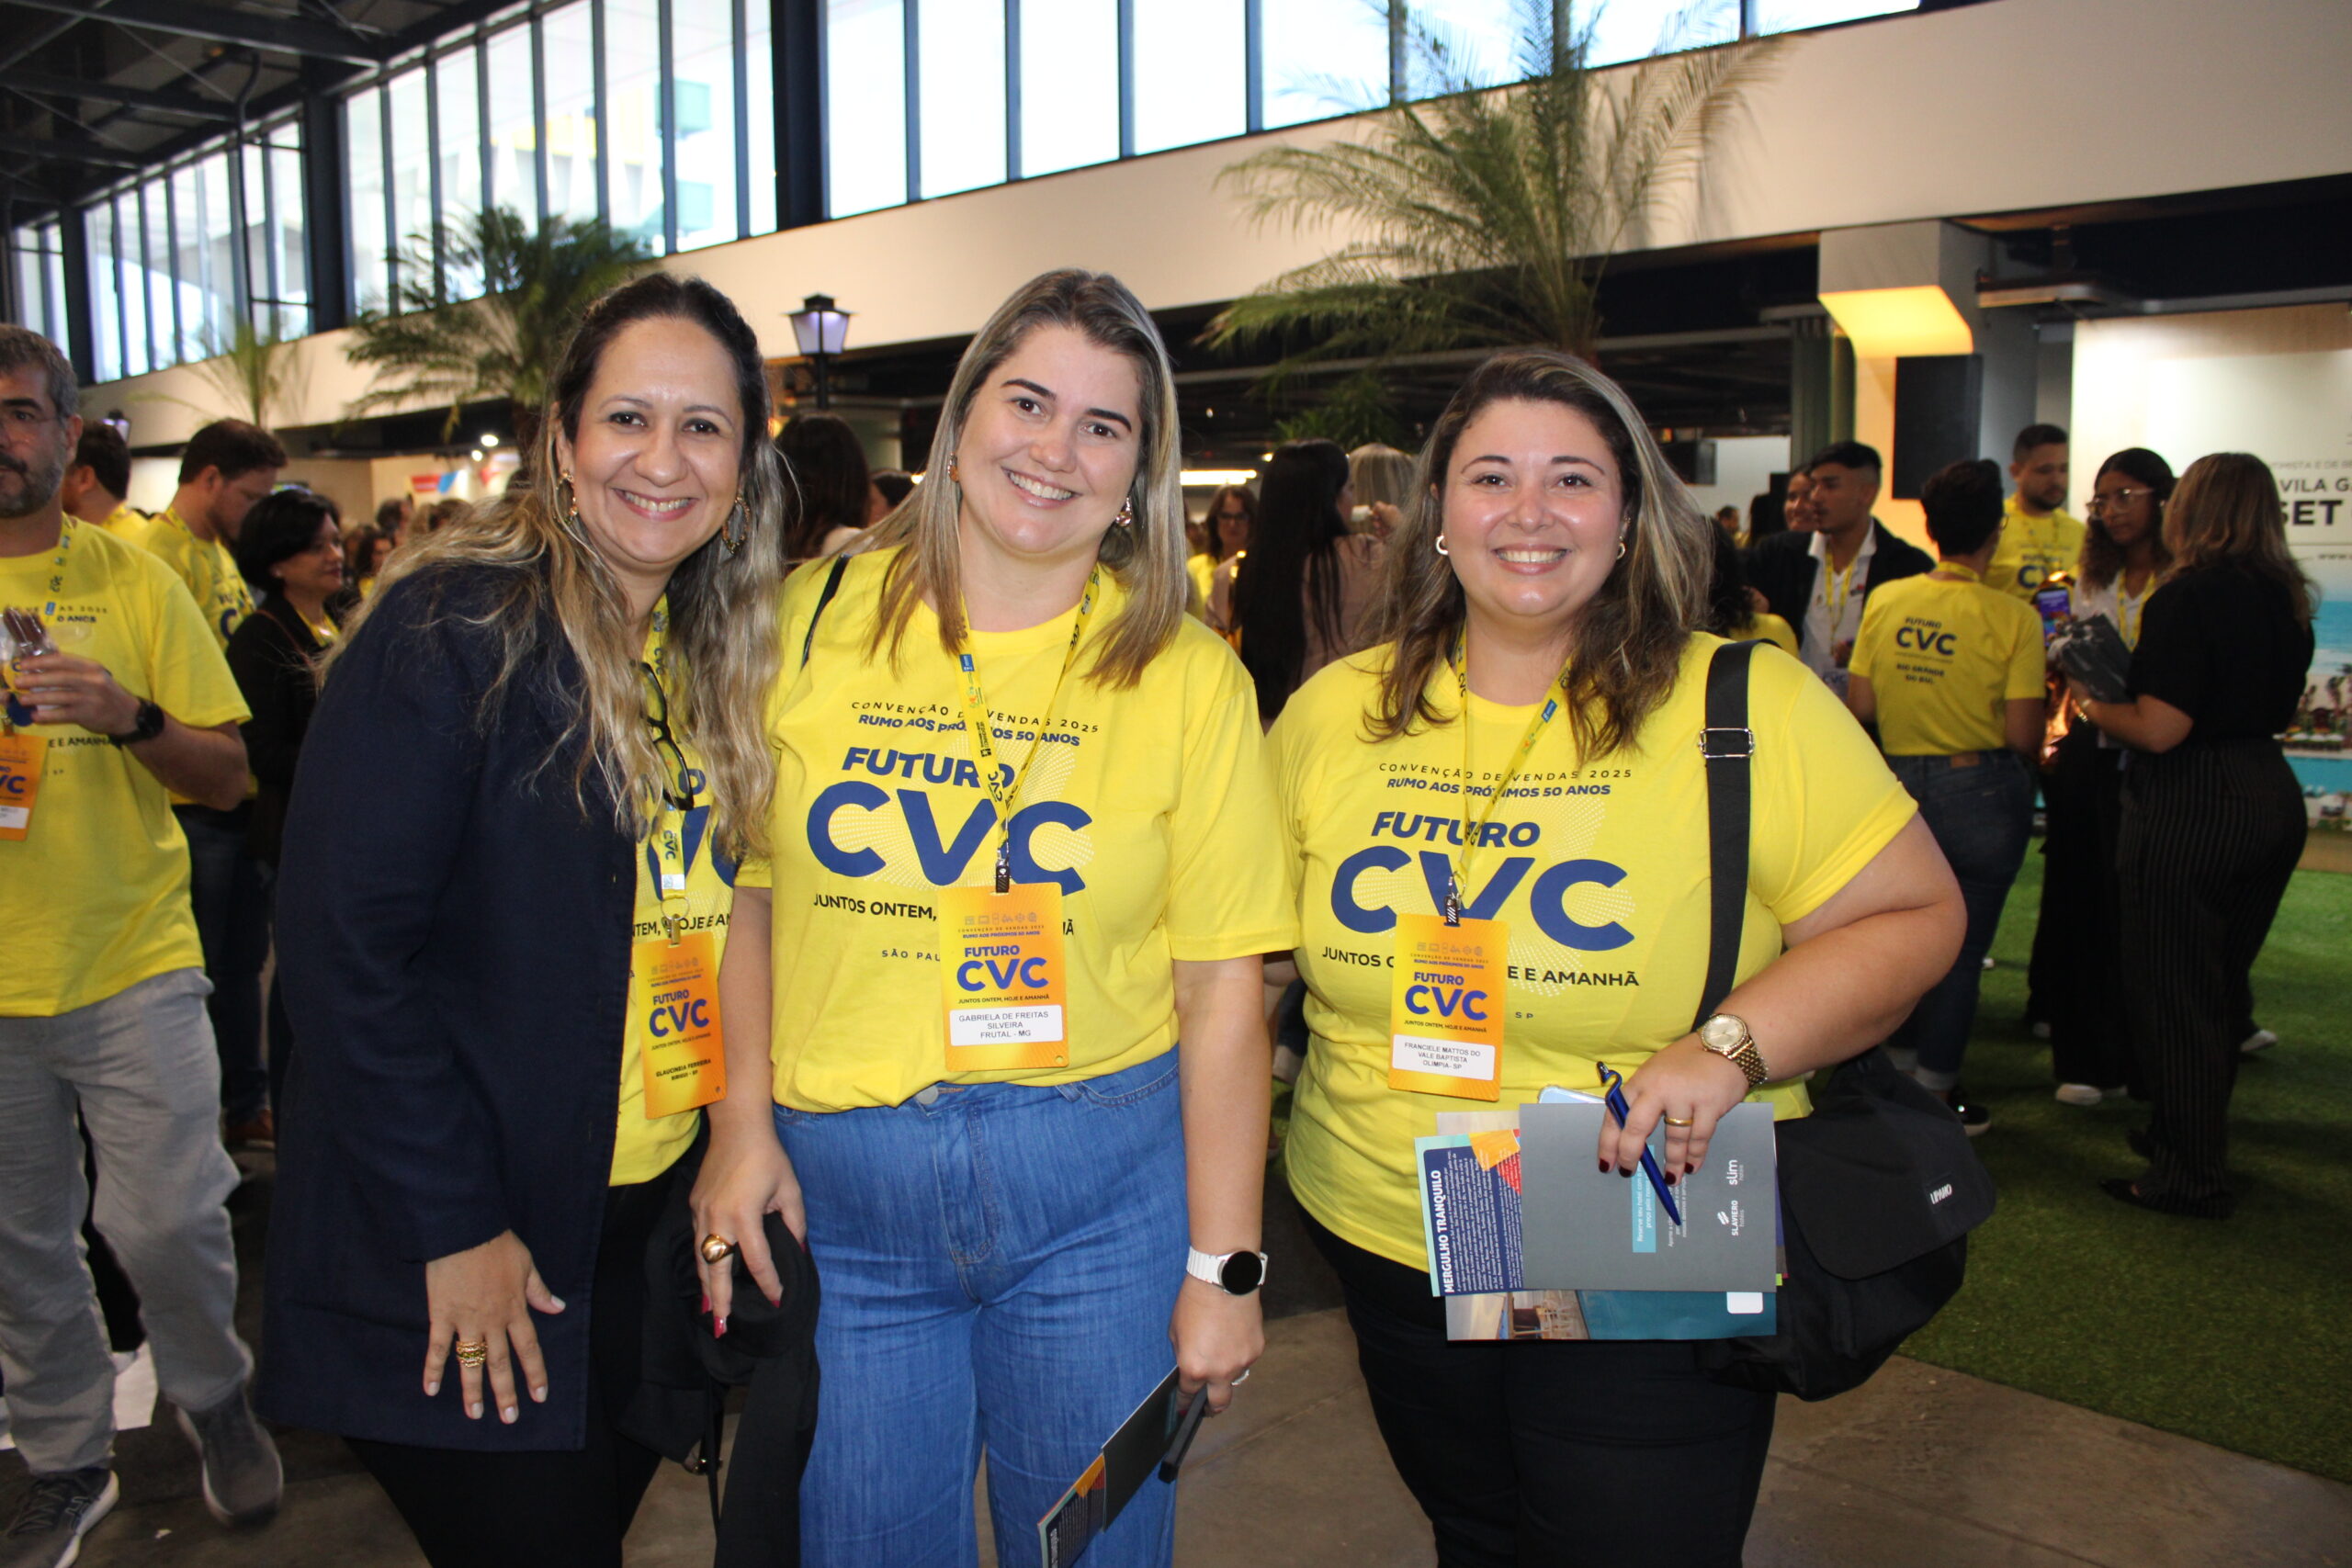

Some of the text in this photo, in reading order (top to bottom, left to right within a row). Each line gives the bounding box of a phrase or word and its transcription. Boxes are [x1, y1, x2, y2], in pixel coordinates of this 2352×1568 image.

[2279, 479, 2326, 492] VILA
[1896, 626, 1957, 656] CVC
[654, 647, 664, 675] CVC
[851, 701, 949, 716] CONVENÇÃO
[986, 709, 1052, 727] VENDAS
[1060, 718, 1100, 733] 2025
[858, 714, 904, 728] RUMO
[906, 716, 936, 732] AOS
[1013, 729, 1035, 742] 50
[1040, 732, 1080, 747] ANOS
[1379, 762, 1632, 782] CONVENÇÃO DE VENDAS 2025
[987, 771, 1003, 802] CVC
[1386, 778, 1611, 797] RUMO AOS PRÓIMOS 50 ANOS
[807, 780, 1093, 897] CVC
[1371, 811, 1541, 848] FUTURO
[663, 829, 677, 860] CVC
[813, 893, 938, 922] JUNTOS ONTEM,
[1330, 845, 1635, 951] CVC
[707, 915, 715, 928] E
[882, 947, 909, 959] SÃO
[964, 944, 1021, 958] FUTURO
[1322, 946, 1381, 967] JUNTOS
[956, 957, 1049, 991] CVC
[1414, 971, 1464, 987] FUTURO
[1525, 967, 1537, 981] E
[1542, 970, 1640, 987] AMANHÃ
[652, 989, 690, 1006] FUTURO
[1405, 985, 1488, 1021] CVC
[649, 998, 710, 1038] CVC
[958, 1013, 1001, 1022] GABRIELA
[987, 1021, 1023, 1030] SILVEIRA
[980, 1030, 1012, 1039] FRUTAL
[1464, 1025, 1487, 1033] AMANHÃ
[1404, 1042, 1442, 1054] FRANCIELE
[1442, 1047, 1470, 1056] MATTOS
[1436, 1054, 1468, 1064] BAPTISTA
[1453, 1062, 1462, 1070] SP
[1725, 1159, 1738, 1186] slim
[1730, 1201, 1739, 1236] SLAVIERO
[1430, 1170, 1455, 1293] MERGULHO TRANQUILO
